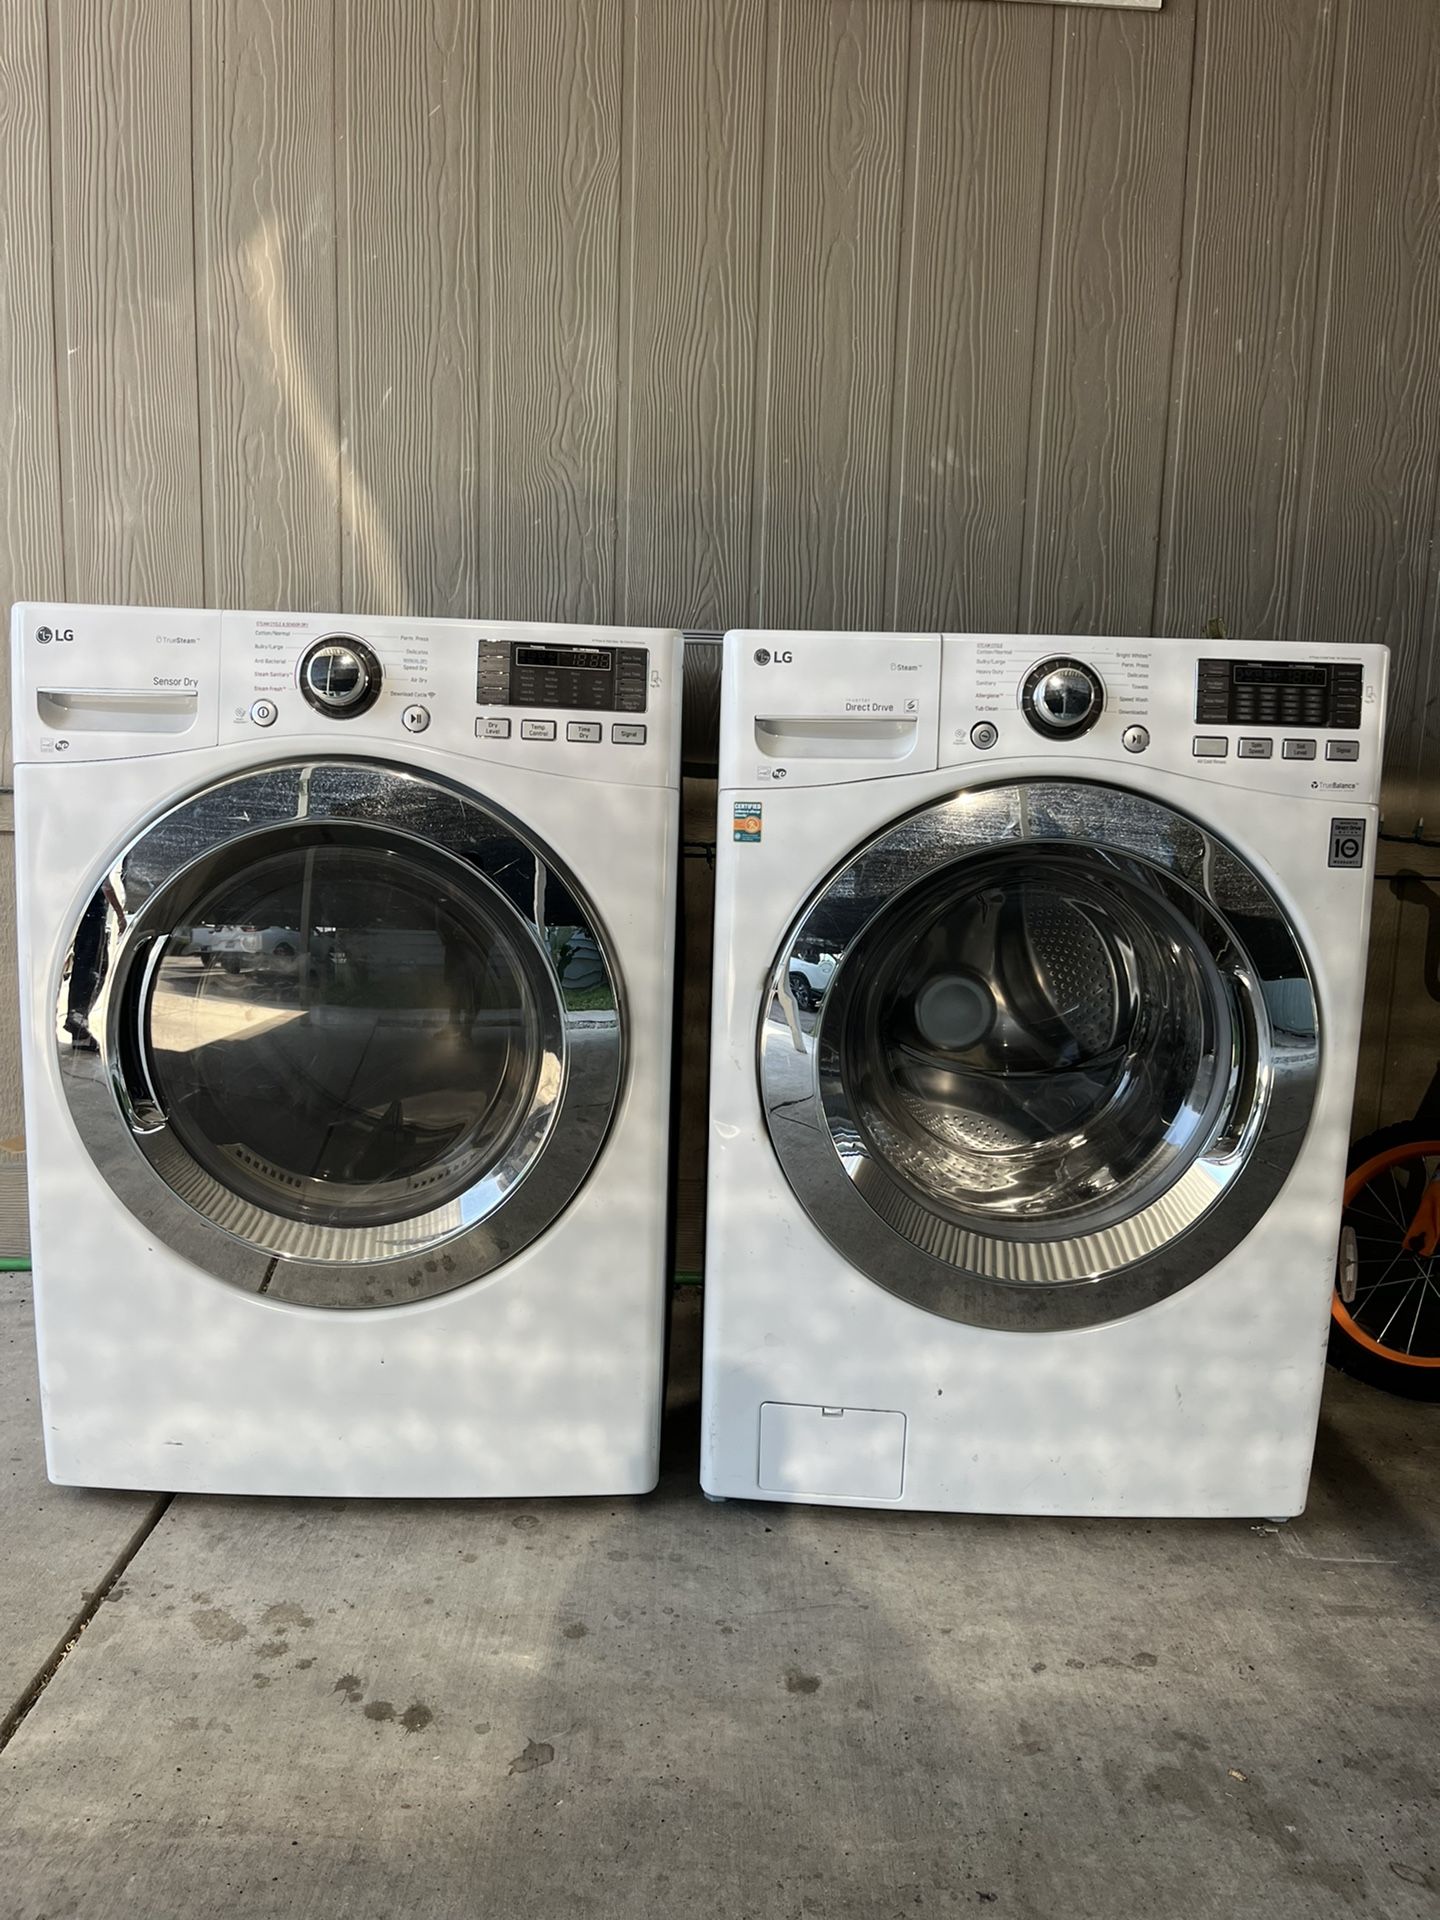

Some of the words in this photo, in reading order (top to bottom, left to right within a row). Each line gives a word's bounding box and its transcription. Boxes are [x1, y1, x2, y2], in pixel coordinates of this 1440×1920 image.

[56, 629, 74, 641] LG
[774, 651, 792, 663] LG
[153, 676, 181, 686] Sensor
[184, 677, 198, 688] Dry
[846, 702, 870, 712] Direct
[872, 703, 894, 712] Drive
[531, 723, 546, 731] Temp
[529, 729, 548, 737] Control
[578, 732, 589, 740] Dry
[620, 730, 637, 738] Signal
[1335, 838, 1359, 858] 10
